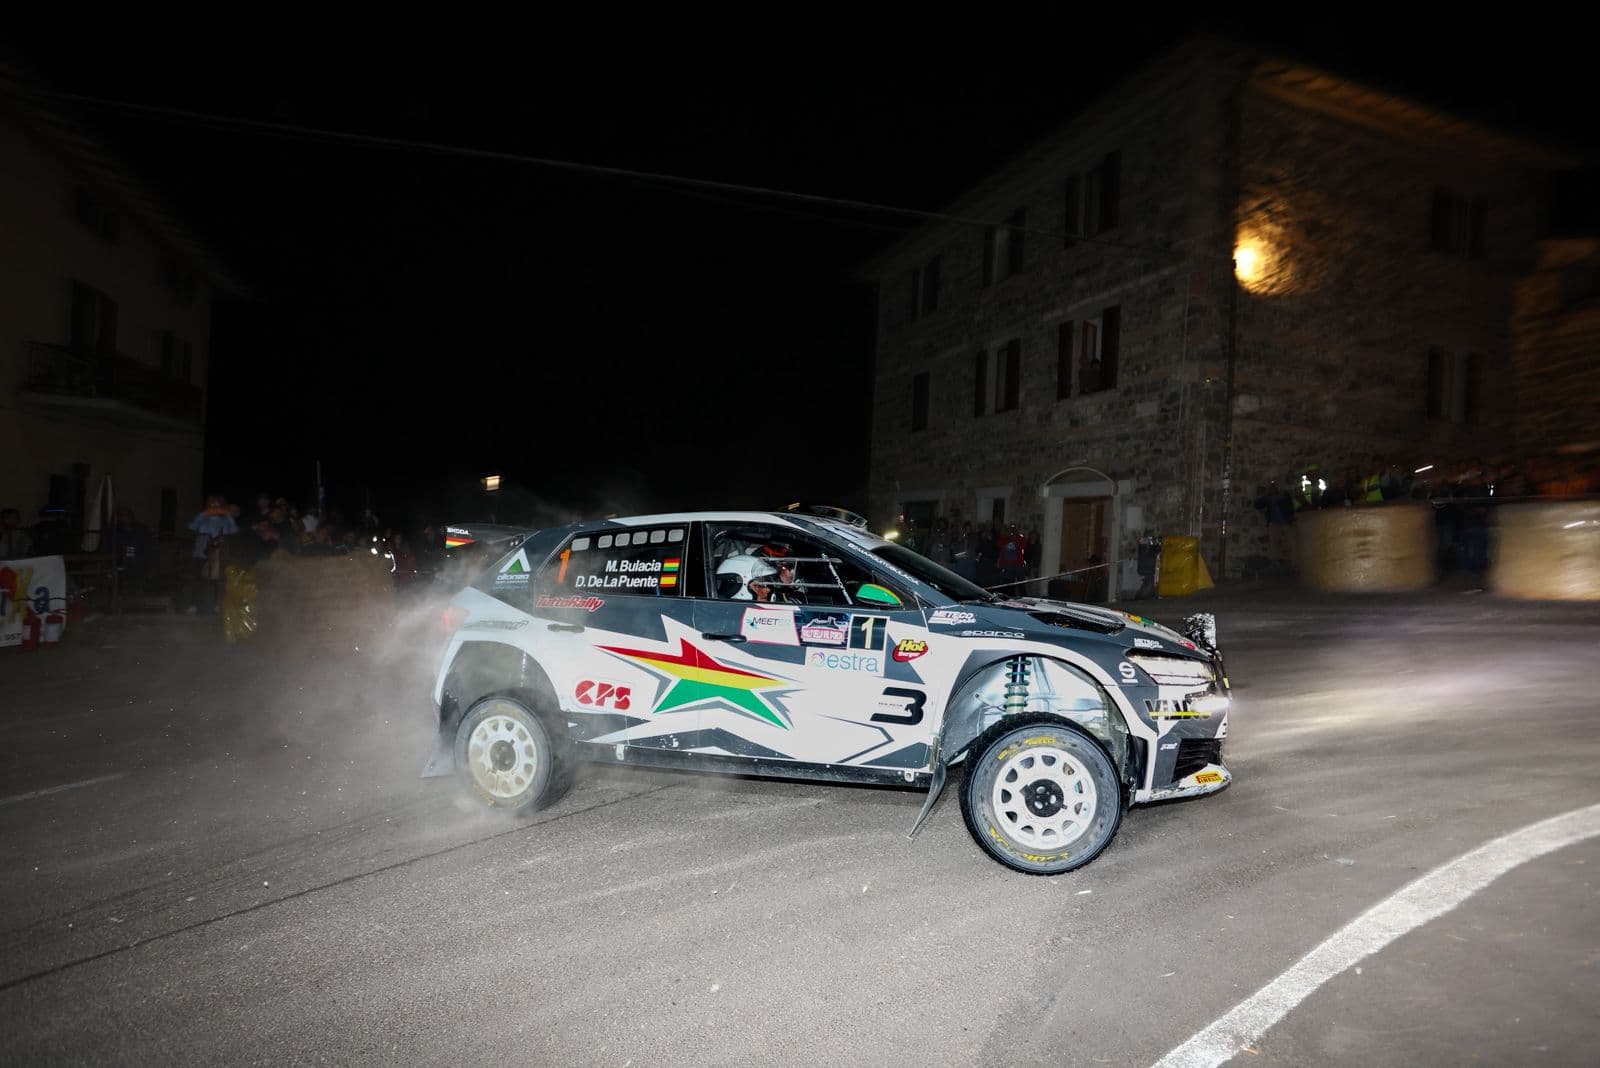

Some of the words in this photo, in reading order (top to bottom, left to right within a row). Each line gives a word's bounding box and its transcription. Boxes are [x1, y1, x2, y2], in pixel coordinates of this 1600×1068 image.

[557, 548, 571, 585] 1
[605, 560, 618, 572] M.
[620, 559, 661, 572] Bulacia
[575, 575, 586, 588] D.
[618, 576, 659, 588] Puente
[752, 616, 780, 626] MEET
[861, 616, 875, 650] 1
[899, 639, 926, 652] Hot
[826, 652, 879, 673] estra
[575, 680, 631, 710] CPS
